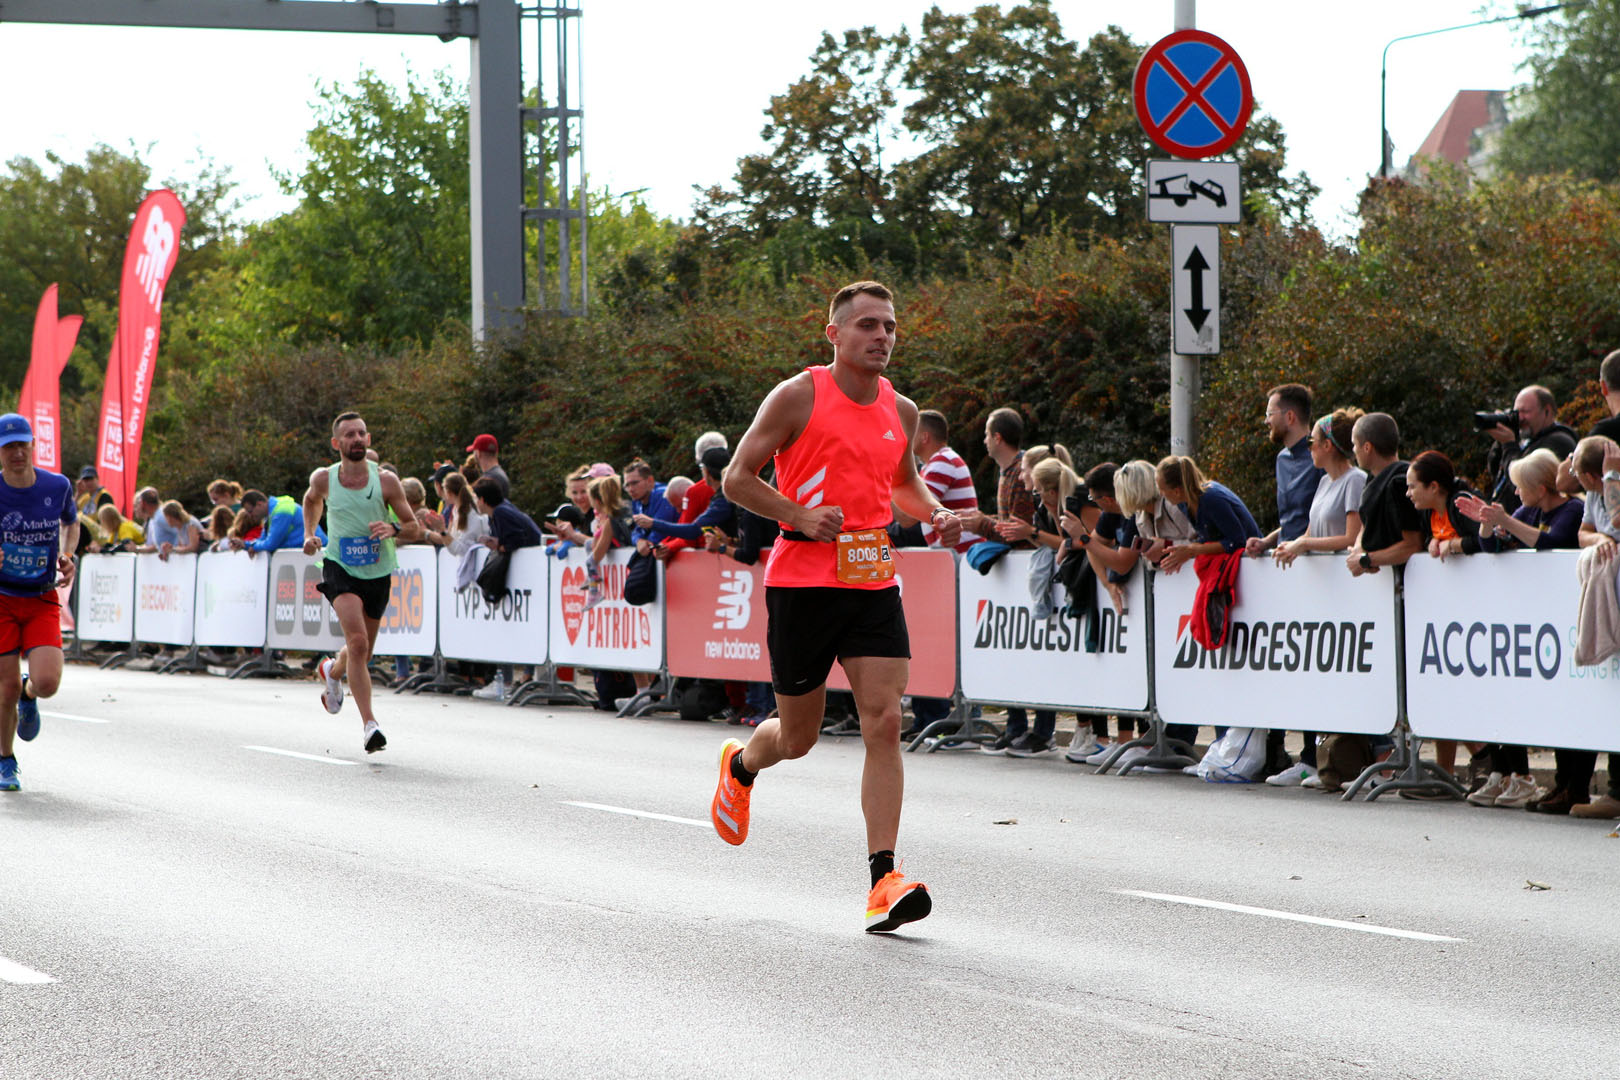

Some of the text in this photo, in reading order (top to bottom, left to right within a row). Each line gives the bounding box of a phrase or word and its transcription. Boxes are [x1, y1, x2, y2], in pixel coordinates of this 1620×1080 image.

[345, 545, 369, 556] 3908
[847, 546, 878, 563] 8008
[453, 586, 480, 619] TVP
[587, 606, 637, 649] PATROL
[974, 600, 1129, 653] BRIDGESTNE
[704, 637, 761, 660] new balance
[1419, 621, 1562, 680] ACCREO
